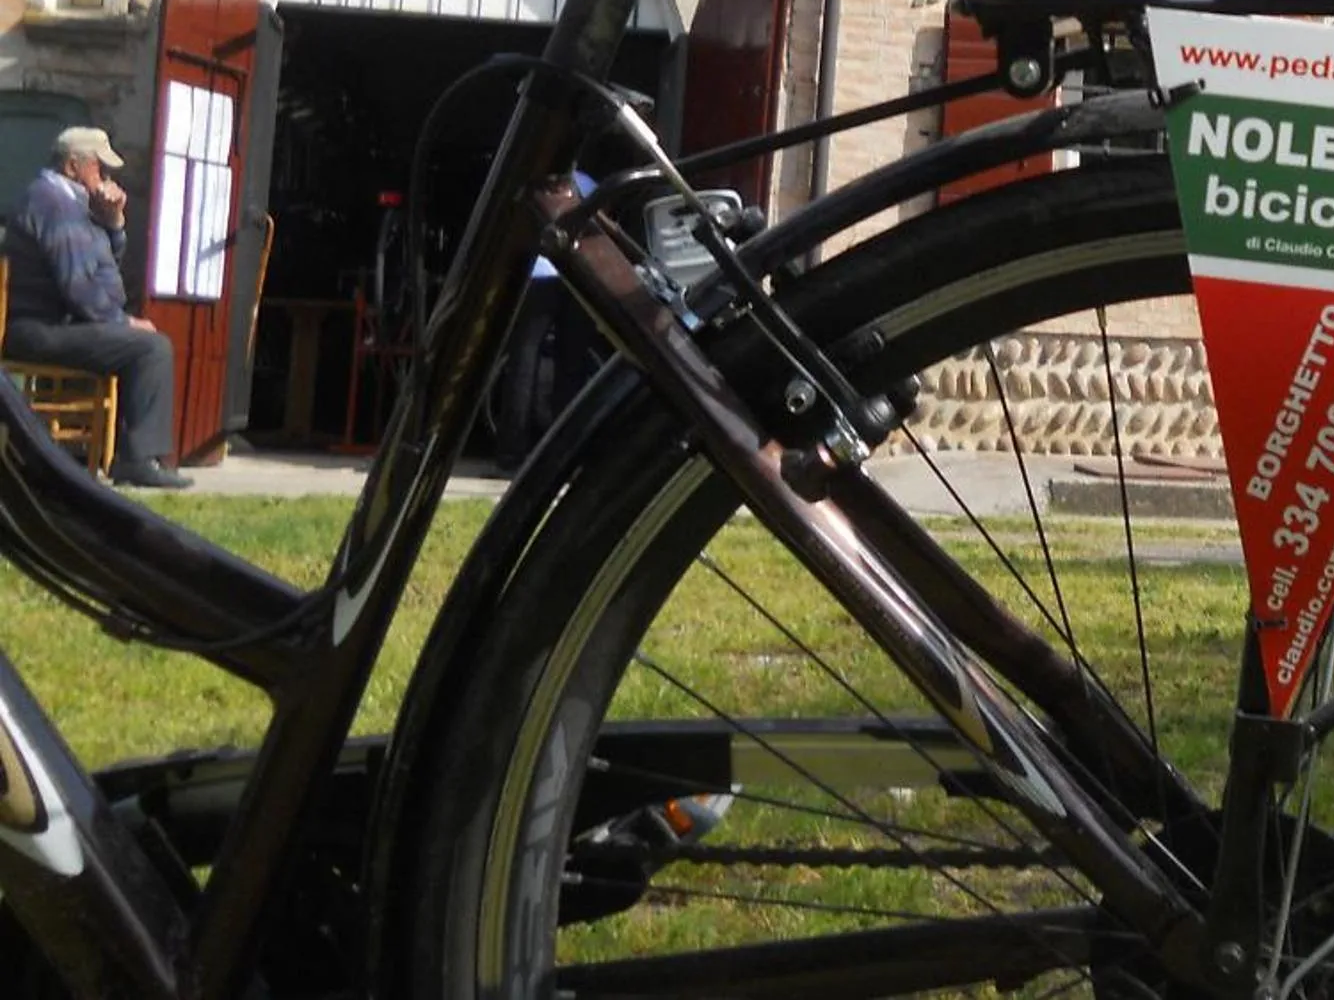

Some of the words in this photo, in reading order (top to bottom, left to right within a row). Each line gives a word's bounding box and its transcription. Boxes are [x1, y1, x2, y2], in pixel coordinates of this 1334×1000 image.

[1246, 236, 1262, 252] di
[1264, 238, 1323, 259] Claudio
[1273, 482, 1331, 557] 334
[1266, 566, 1298, 612] cell.
